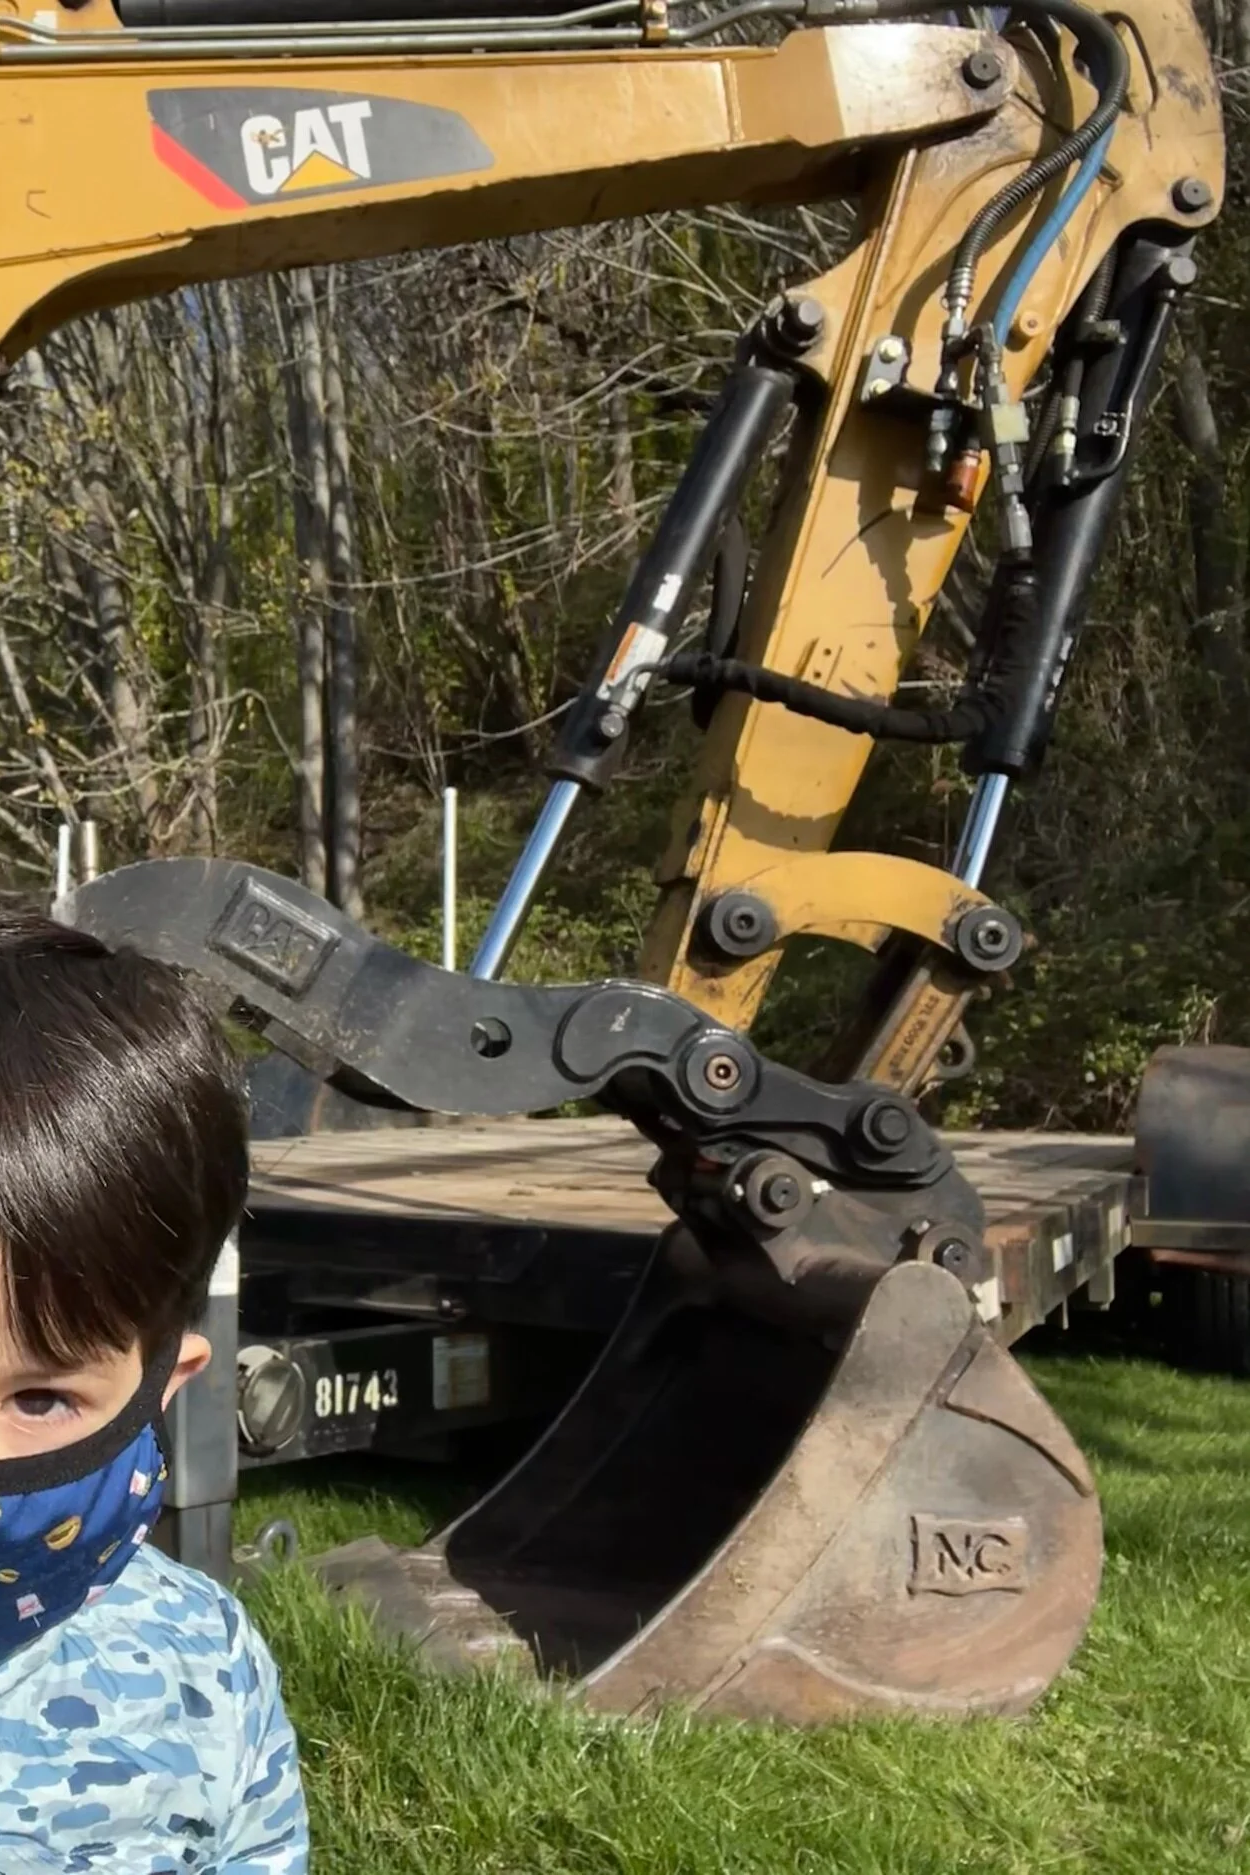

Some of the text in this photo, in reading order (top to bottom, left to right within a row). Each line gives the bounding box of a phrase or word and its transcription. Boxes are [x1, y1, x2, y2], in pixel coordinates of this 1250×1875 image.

[240, 100, 373, 196] CAT
[315, 1368, 398, 1417] 81743
[933, 1532, 1012, 1579] NC
